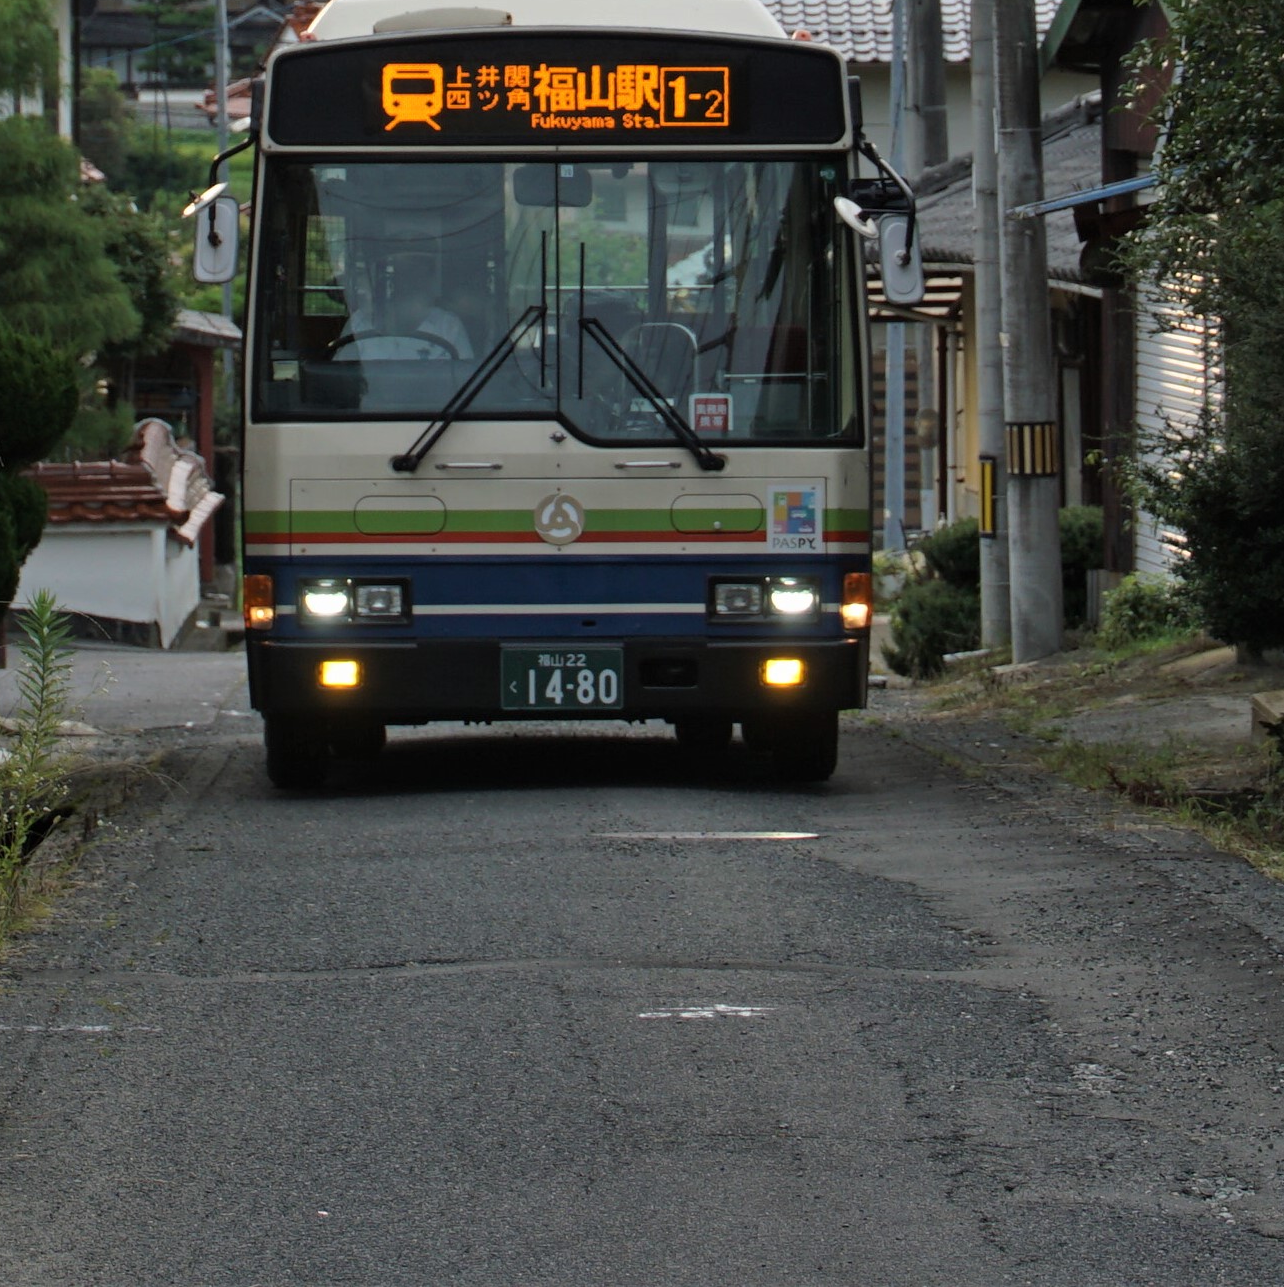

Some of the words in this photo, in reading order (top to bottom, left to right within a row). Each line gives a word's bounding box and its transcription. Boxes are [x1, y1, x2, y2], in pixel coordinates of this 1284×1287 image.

[446, 65, 530, 88] 上井関
[533, 63, 660, 112] 福山駅
[446, 88, 531, 111] 四ツ角
[668, 75, 723, 118] 1-2
[531, 113, 615, 131] Fukuyama
[622, 113, 661, 129] Sta.
[772, 537, 816, 550] PASPY
[529, 669, 617, 704] 14-80
